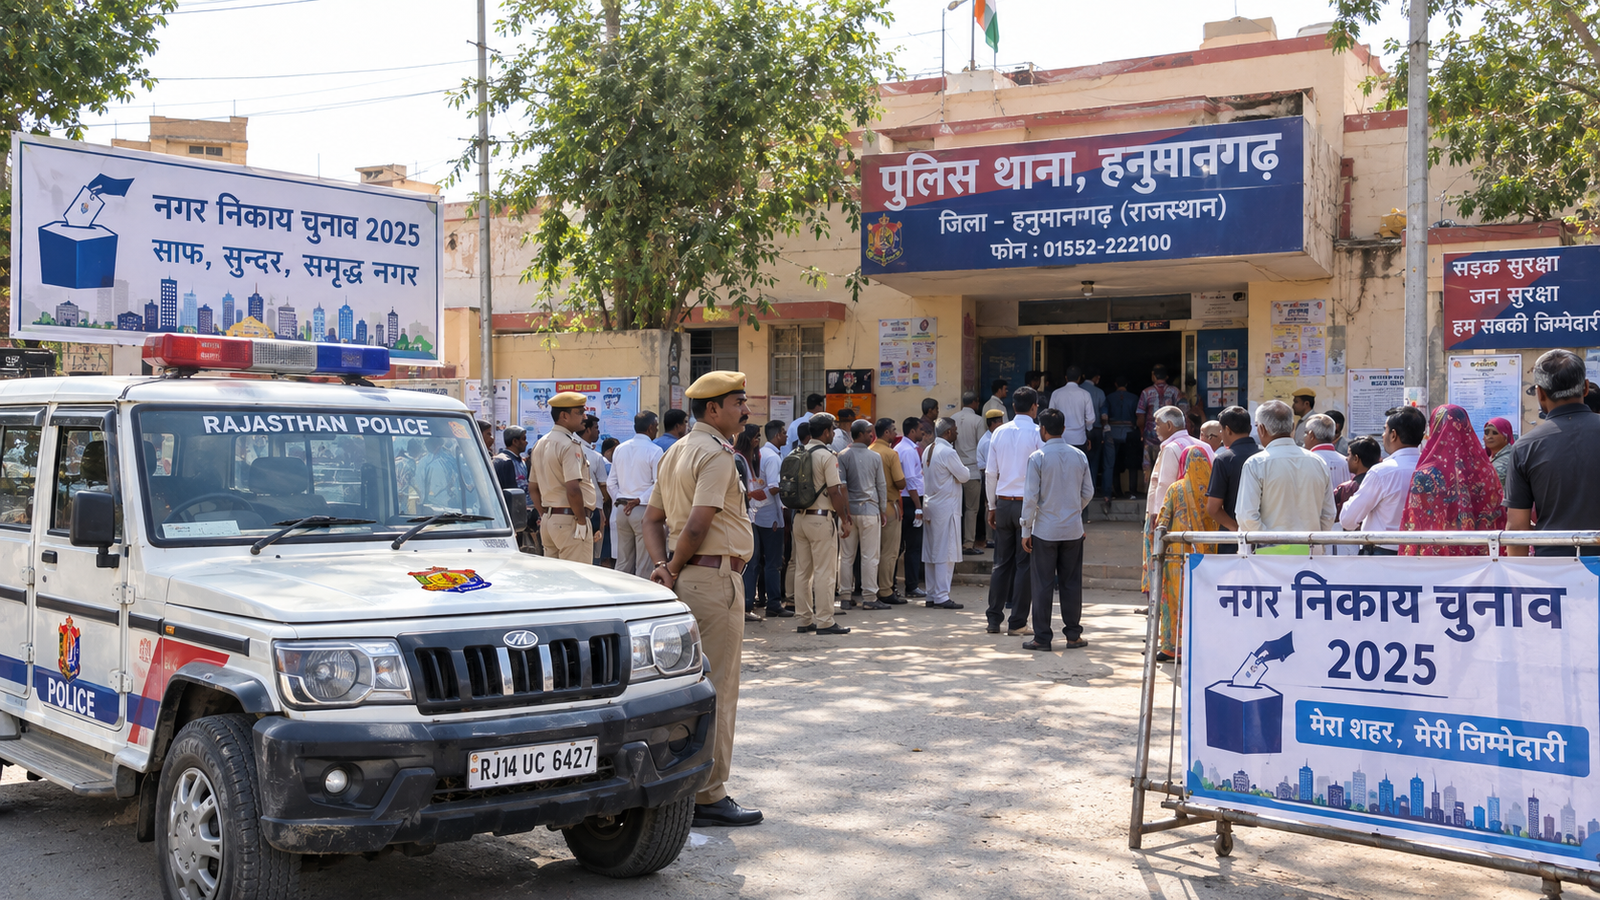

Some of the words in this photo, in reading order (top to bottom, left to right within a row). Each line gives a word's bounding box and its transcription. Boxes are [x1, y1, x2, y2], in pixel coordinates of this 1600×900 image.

[879, 152, 980, 212] पुलिस
[993, 151, 1086, 194] थाना,
[1098, 132, 1282, 194] हनुमानगढ़
[152, 194, 208, 223] नगर
[216, 192, 294, 232] निकाय
[301, 210, 359, 244] चुनाव
[366, 217, 420, 247] 2025
[938, 209, 988, 235] जिला
[1120, 193, 1226, 227] (राजस्थान)
[152, 239, 211, 270] साफ,
[222, 246, 291, 278] सुन्दर,
[302, 254, 365, 288] समृद्ध
[372, 262, 419, 287] नगर
[990, 238, 1027, 260] फोन
[1043, 233, 1171, 258] 01552-222100
[1452, 259, 1501, 279] सड़क
[1506, 255, 1560, 279] सुरक्षा
[1469, 288, 1501, 304] जन
[1507, 286, 1560, 308] सुरक्षा
[1452, 319, 1476, 337] हम
[1480, 312, 1529, 334] सबकी
[202, 414, 348, 435] RAJASTHAN
[356, 416, 432, 436] POLICE
[1217, 584, 1282, 619] नगर
[1290, 569, 1423, 624] निकाय
[1433, 585, 1567, 642] चुनाव
[1327, 638, 1437, 686] 2025
[47, 677, 95, 719] POLICE
[1309, 708, 1344, 738] मेरा
[1349, 718, 1403, 749] शहर,
[1413, 717, 1452, 750] मेरी
[1457, 721, 1568, 763] जिम्मेदारी
[480, 756, 518, 782] RJ14
[523, 752, 545, 775] UC
[552, 746, 594, 771] 6427
